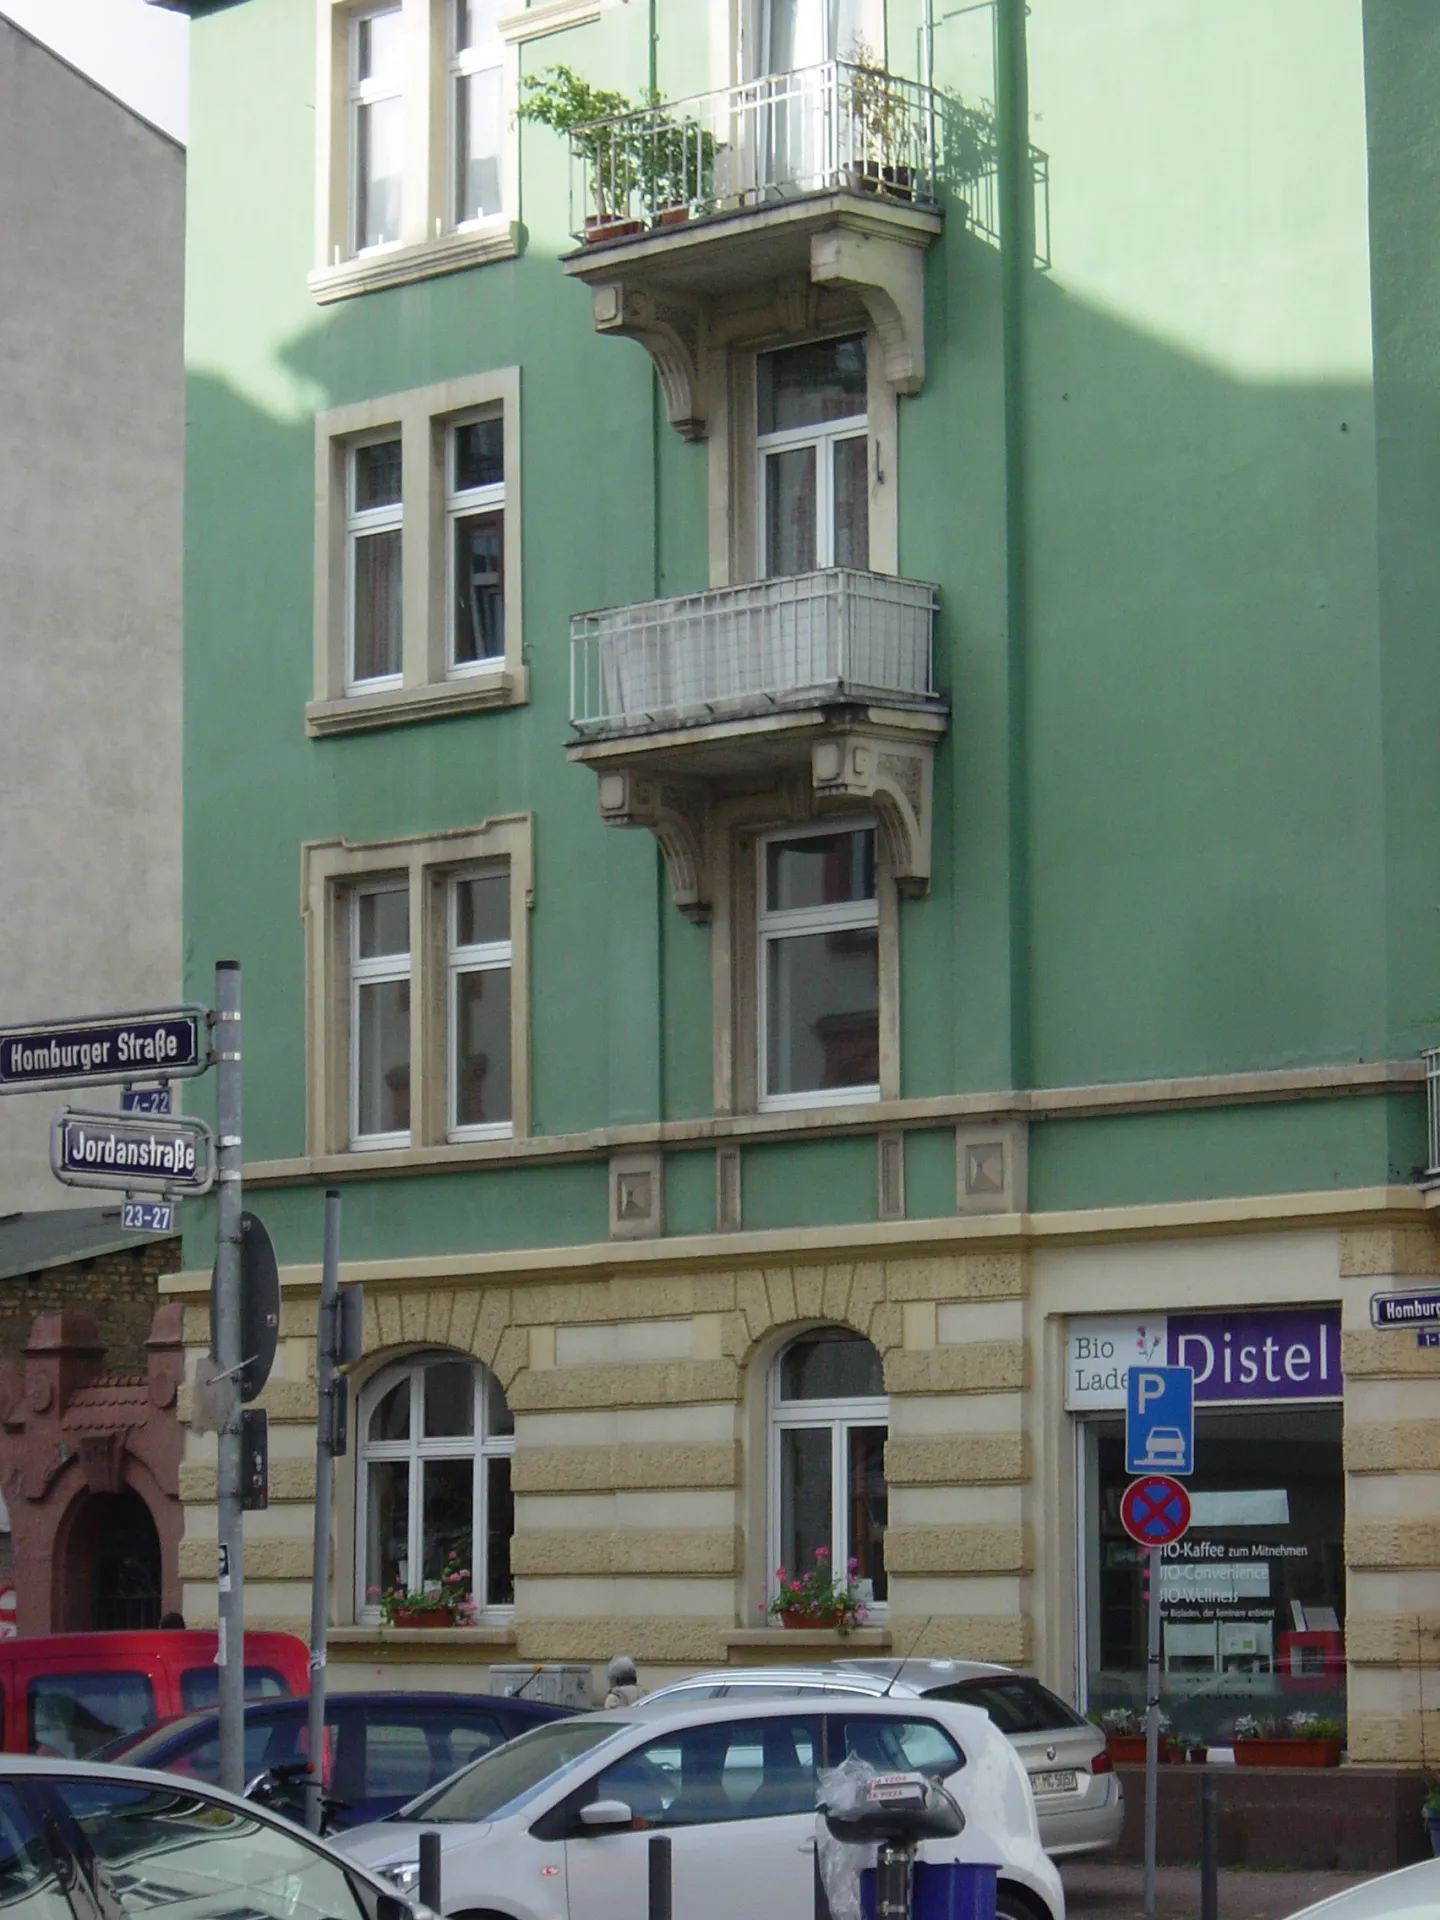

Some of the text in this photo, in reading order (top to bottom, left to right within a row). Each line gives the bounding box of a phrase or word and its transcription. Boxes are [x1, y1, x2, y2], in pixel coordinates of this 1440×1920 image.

[10, 1028, 177, 1072] Homburger Straße
[132, 1092, 168, 1114] 4-22
[72, 1130, 195, 1173] Jordanstraße
[125, 1205, 170, 1229] 23-27
[1075, 1337, 1115, 1360] Bio
[1178, 1324, 1328, 1385] Distel
[1074, 1368, 1128, 1392] Lade
[1138, 1373, 1166, 1415] P
[1159, 1541, 1308, 1558] IO-Kaffee zum Mitnehmen
